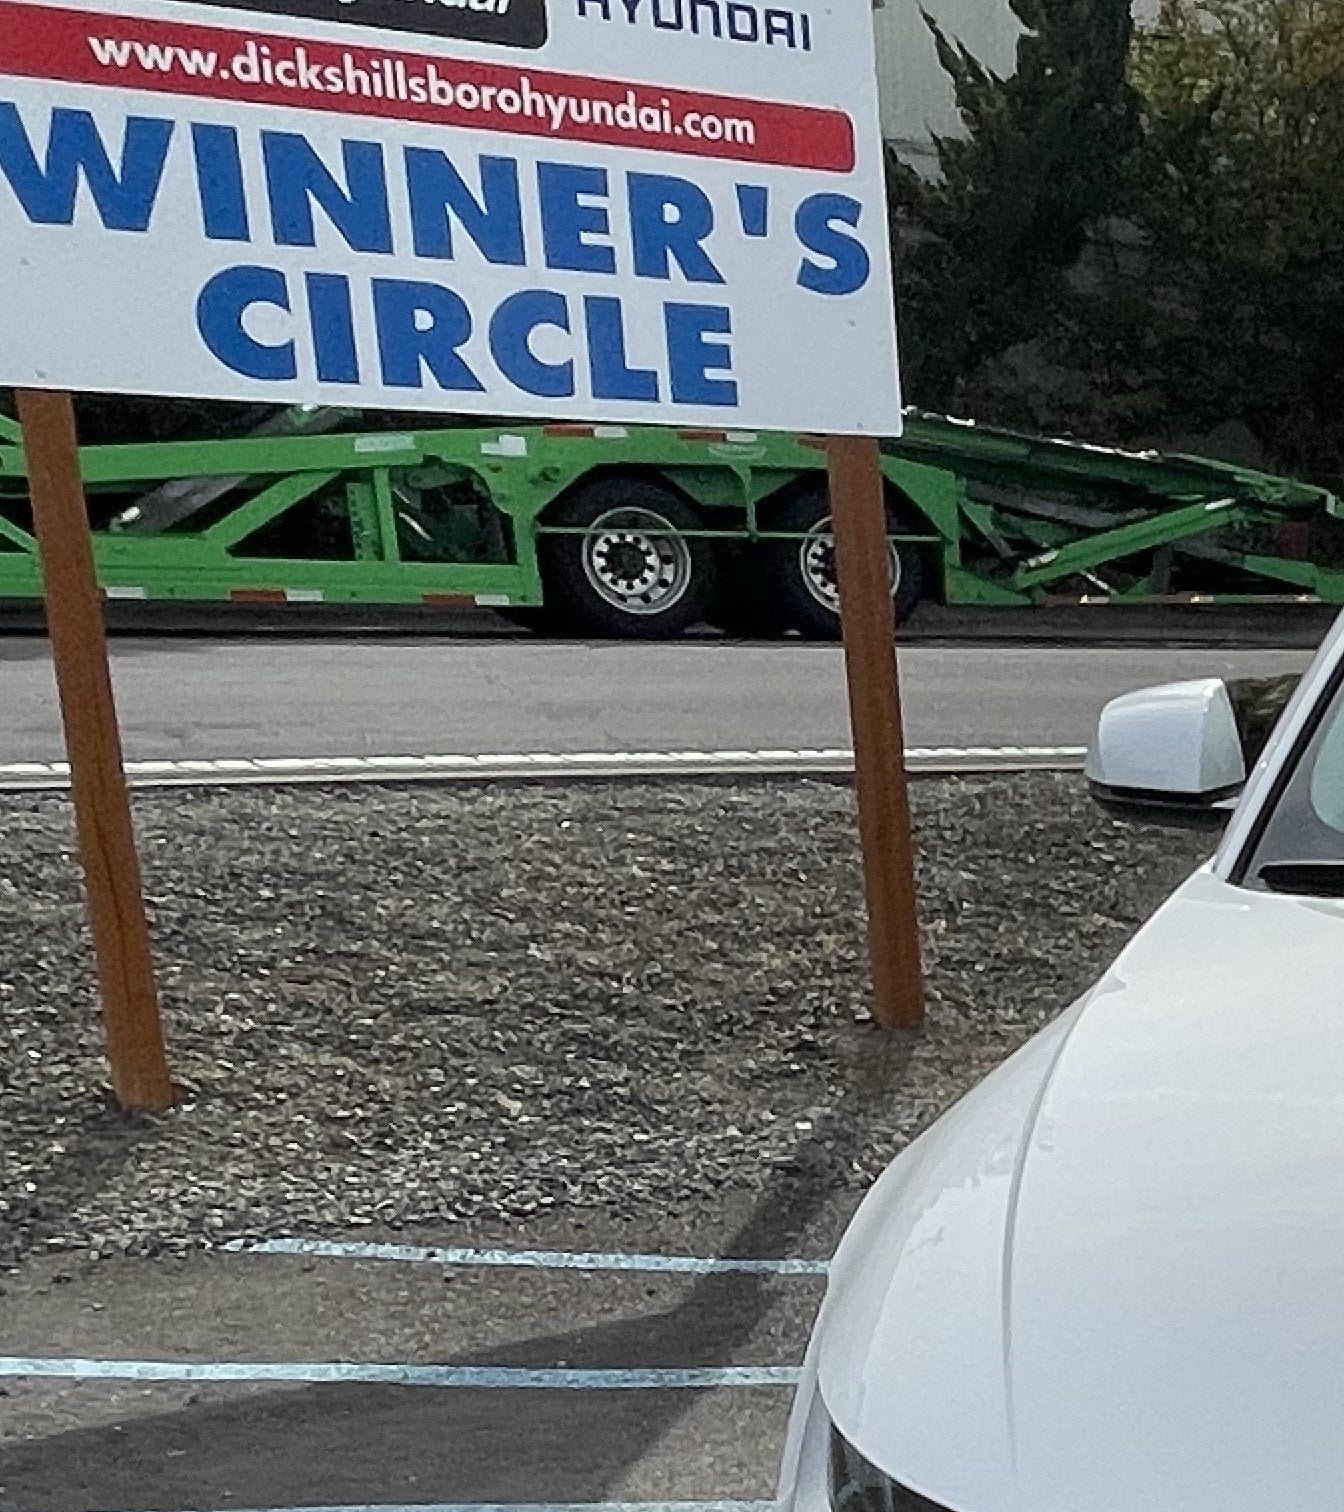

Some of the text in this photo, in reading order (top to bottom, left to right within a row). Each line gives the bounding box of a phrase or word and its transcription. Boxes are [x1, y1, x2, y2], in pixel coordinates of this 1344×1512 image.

[89, 34, 757, 147] www.dickshillsborohyundai.com
[0, 101, 871, 297] WINNER'S
[195, 264, 740, 408] CIRCLE
